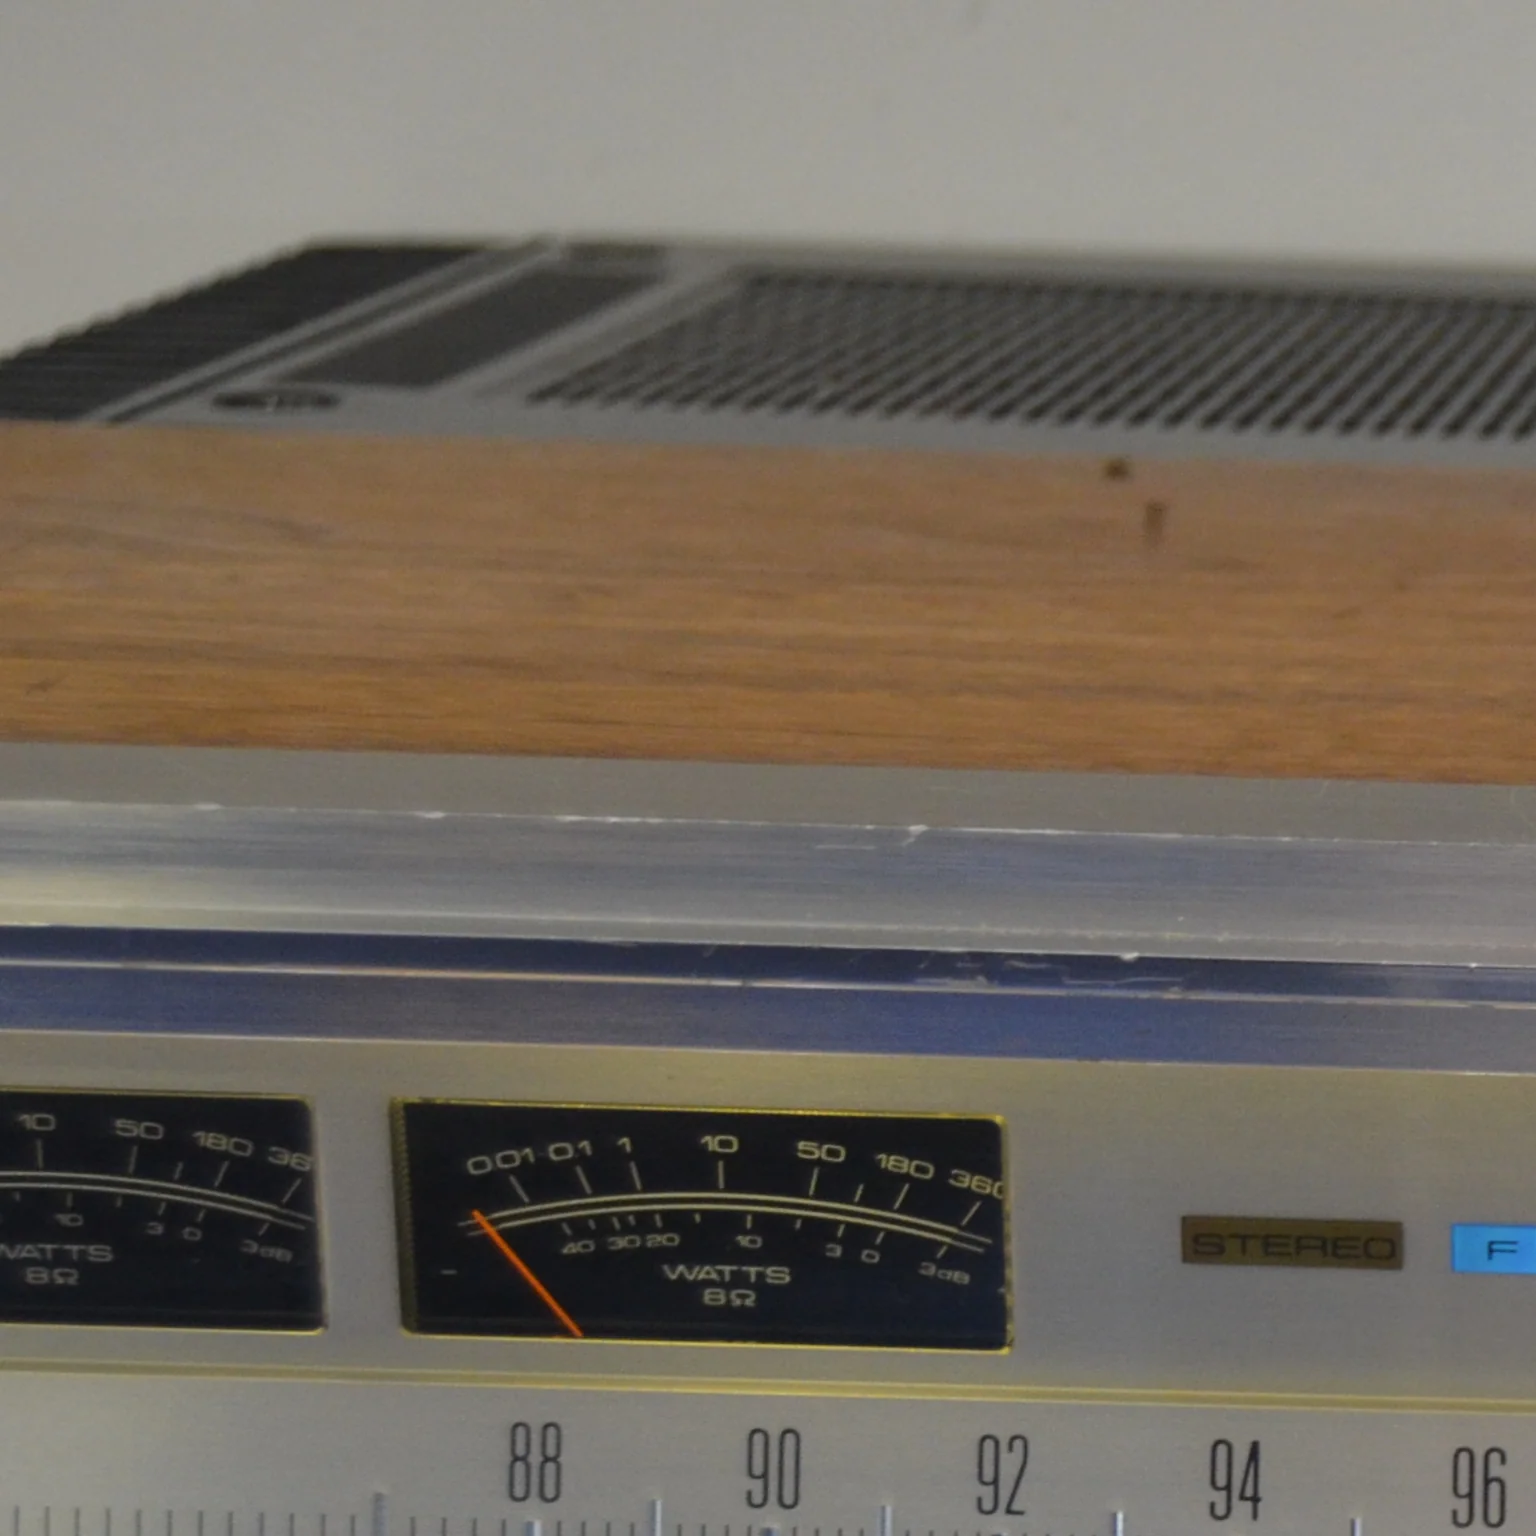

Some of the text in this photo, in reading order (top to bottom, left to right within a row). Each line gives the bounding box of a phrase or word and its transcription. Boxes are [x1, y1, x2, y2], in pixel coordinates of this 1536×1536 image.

[18, 1114, 313, 1171] 10 50 180 36
[617, 1137, 631, 1153] 1
[700, 1135, 739, 1153] 10
[797, 1141, 846, 1163] 50
[876, 1153, 934, 1180] 180
[55, 1214, 83, 1227] 10
[146, 1222, 164, 1235] 3
[182, 1227, 202, 1241] 0
[561, 1240, 596, 1254] 40
[608, 1235, 641, 1250] 30
[646, 1234, 680, 1247] 20
[735, 1235, 763, 1248] 10
[825, 1244, 842, 1258] 3
[861, 1249, 881, 1264] 0
[1191, 1232, 1397, 1262] STEREO
[662, 1264, 790, 1285] WATTS
[508, 1422, 562, 1502] 88
[746, 1428, 800, 1509] 90
[976, 1434, 1028, 1515] 92
[1209, 1439, 1261, 1521] 94
[1451, 1447, 1507, 1528] 96
